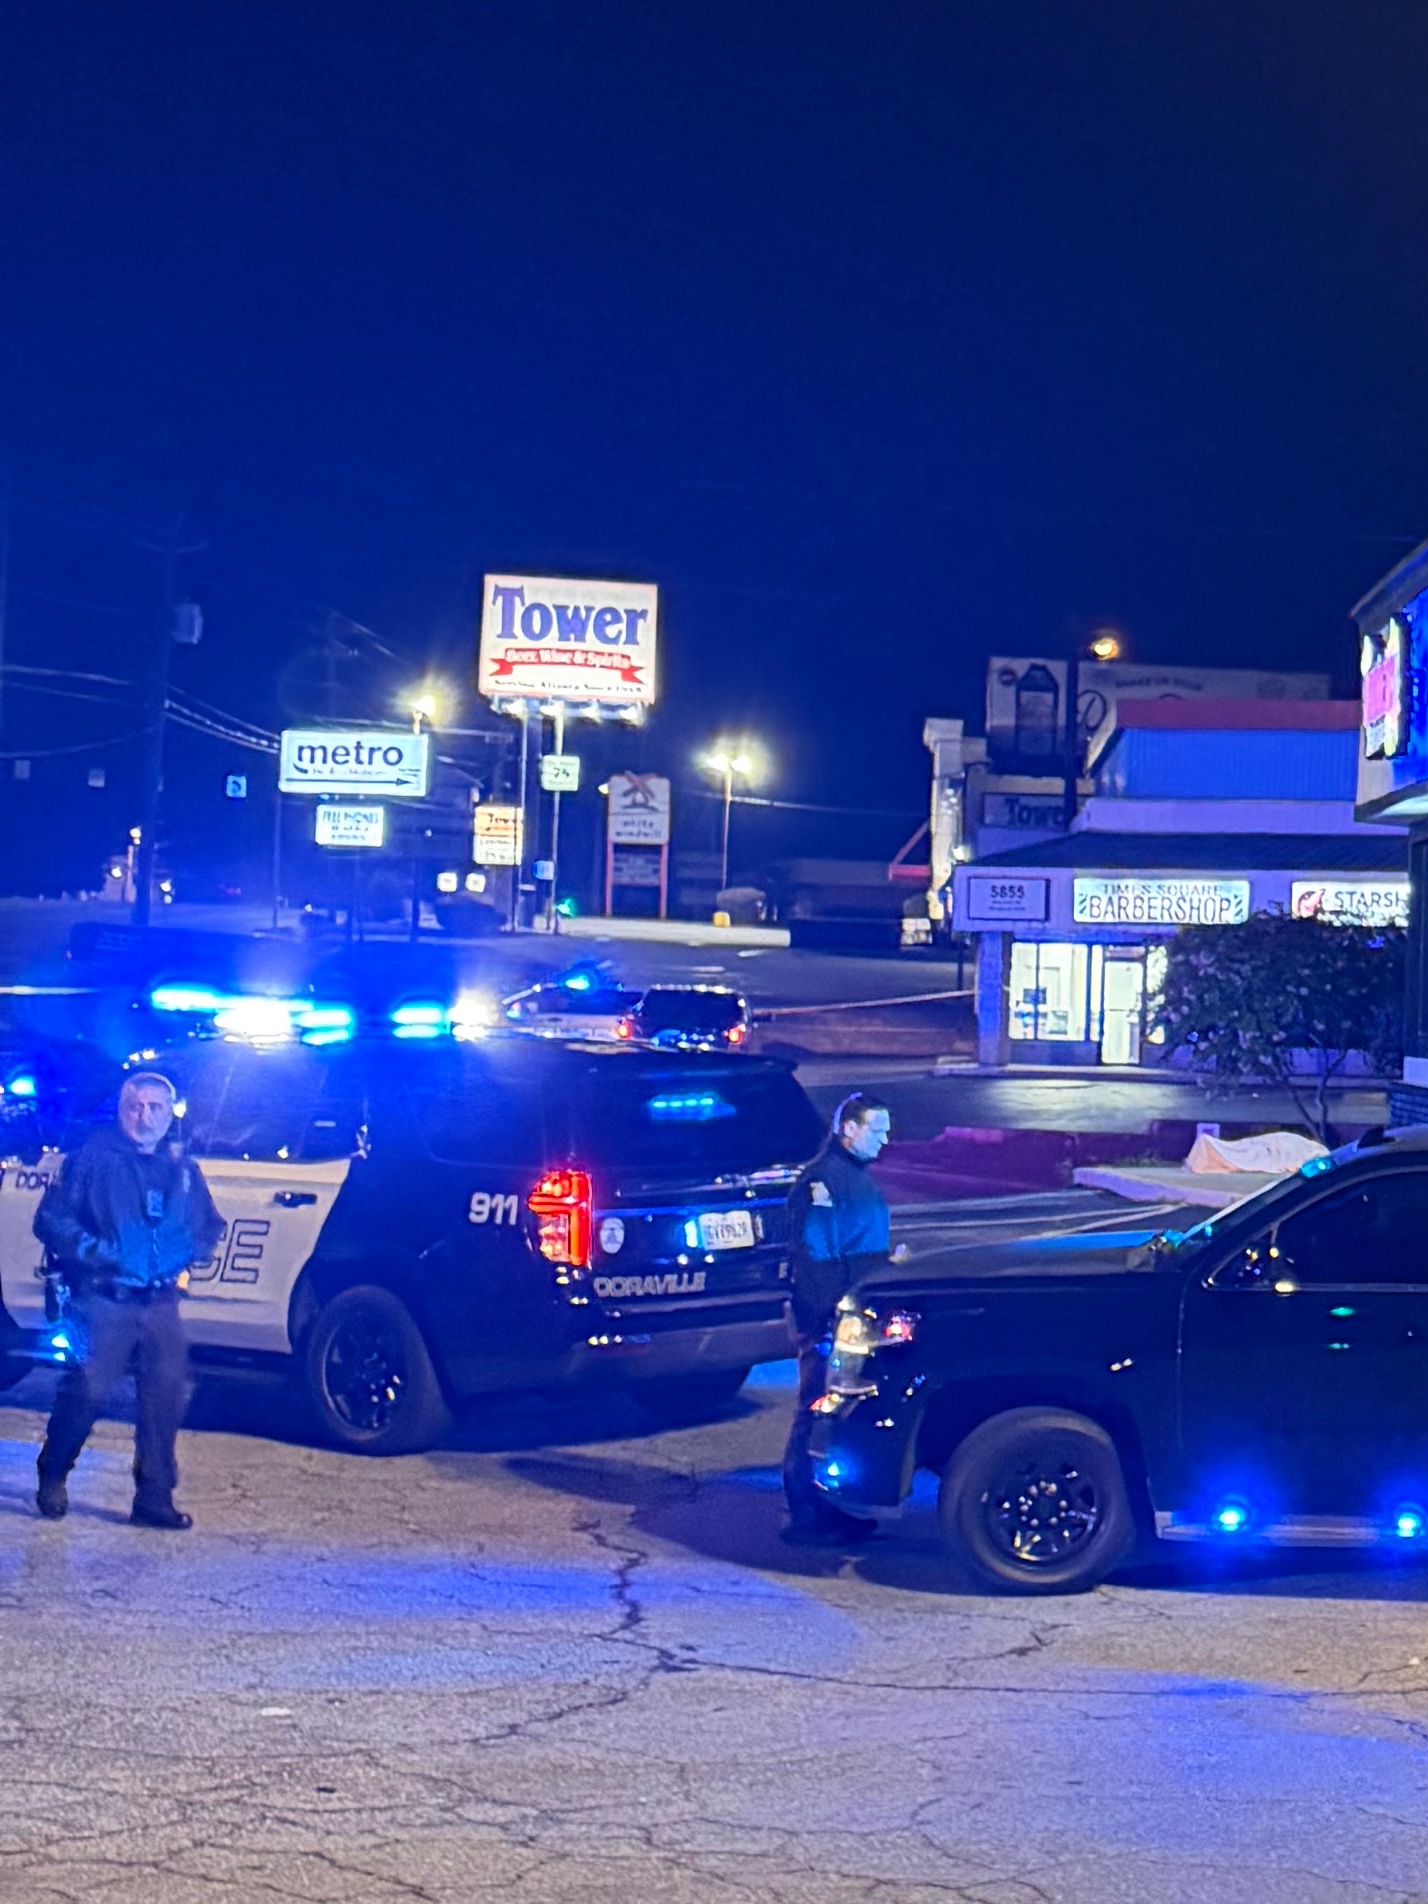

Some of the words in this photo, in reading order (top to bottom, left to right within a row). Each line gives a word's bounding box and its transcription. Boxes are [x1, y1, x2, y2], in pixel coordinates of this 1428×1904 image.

[492, 584, 649, 645] Tower
[297, 740, 404, 766] metro
[1103, 883, 1151, 895] TIMES
[1156, 884, 1222, 896] SQUARE
[1089, 895, 1231, 923] BARBERSHOP
[468, 1191, 519, 1226] 911
[593, 1271, 706, 1298] DORAVILLE
